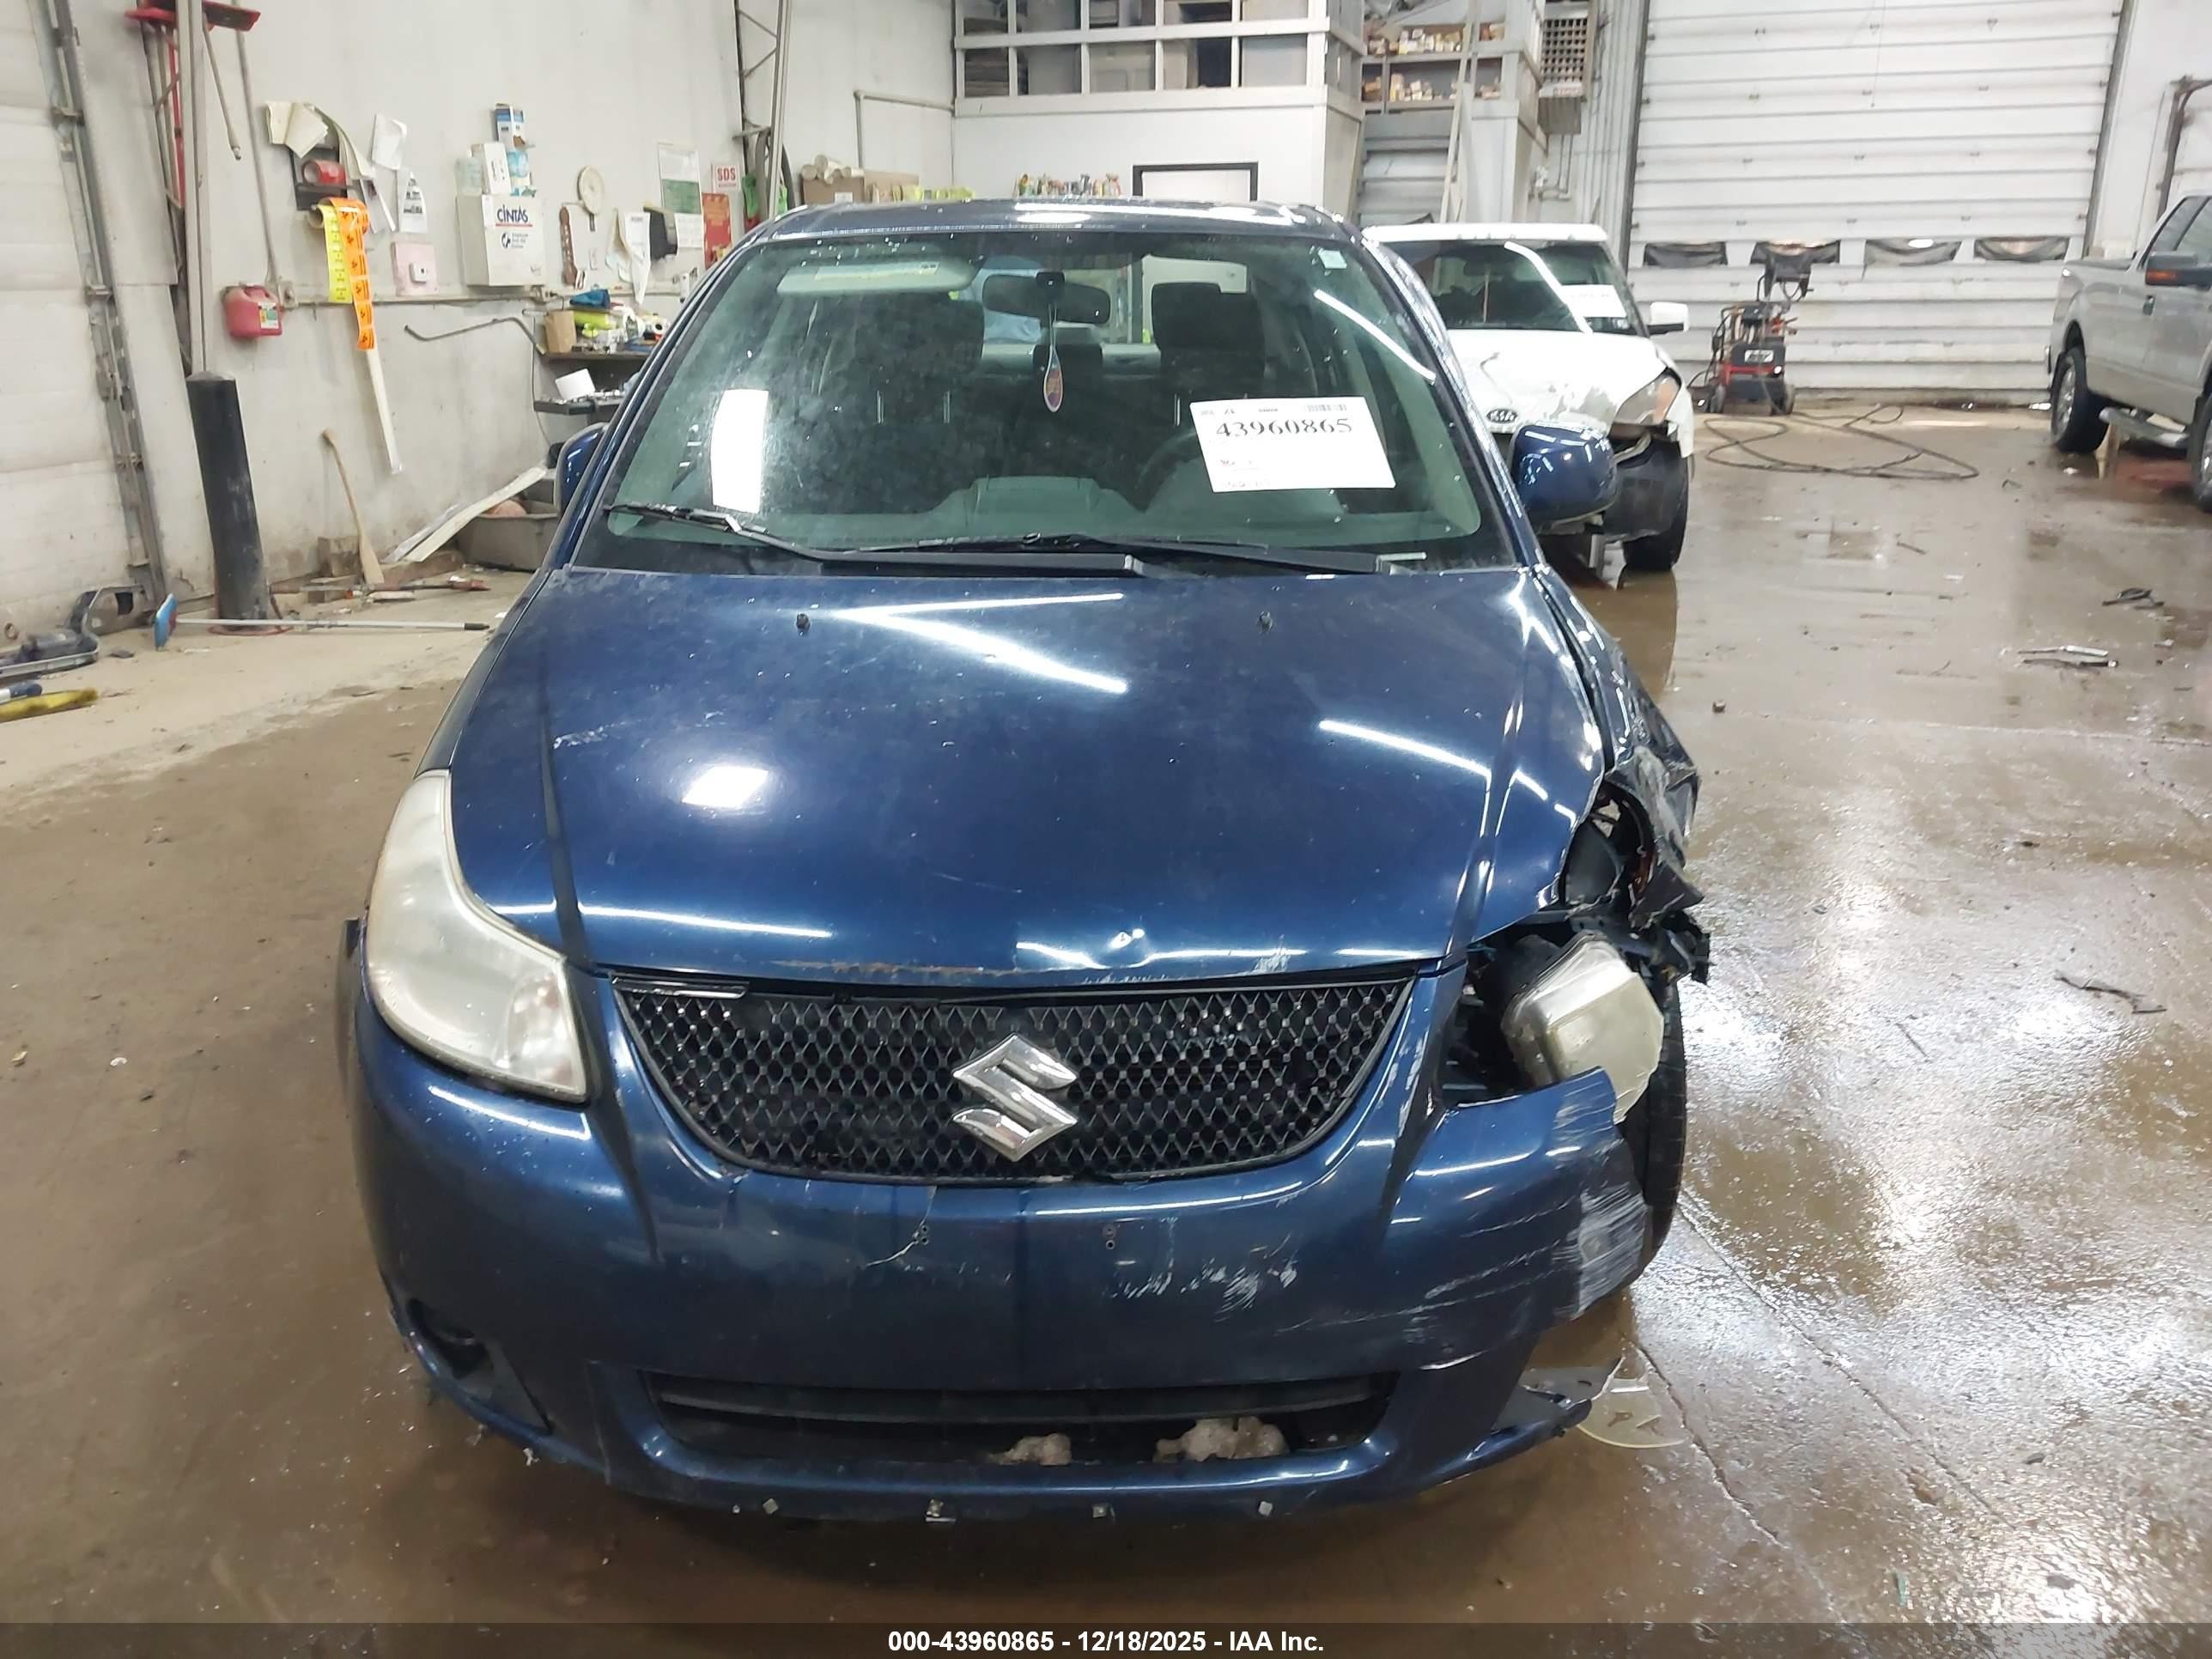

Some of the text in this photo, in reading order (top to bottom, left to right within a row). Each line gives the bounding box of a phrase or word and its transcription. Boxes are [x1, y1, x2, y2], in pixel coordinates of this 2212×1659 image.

[717, 167, 737, 181] SDS
[496, 204, 529, 223] CINTAS
[1216, 417, 1352, 437] 43960865
